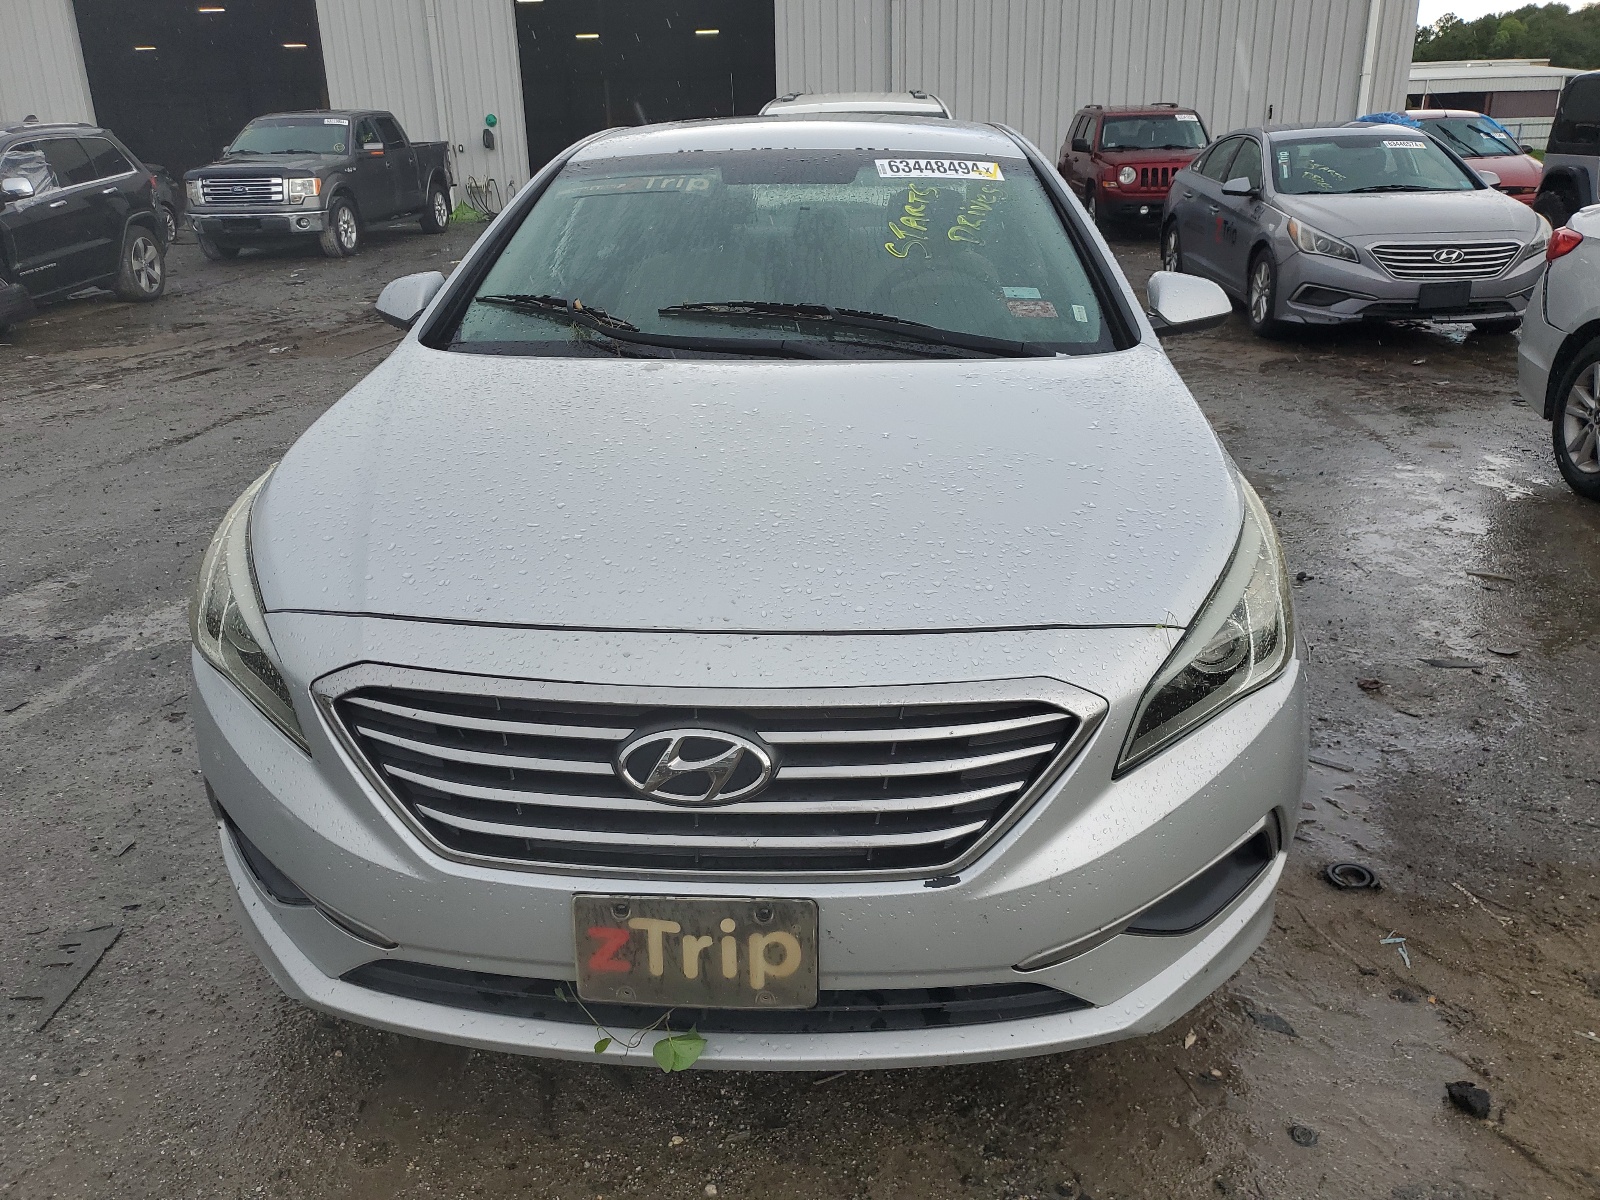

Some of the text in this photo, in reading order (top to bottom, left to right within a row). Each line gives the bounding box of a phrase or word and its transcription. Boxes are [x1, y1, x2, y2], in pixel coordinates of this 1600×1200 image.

[888, 159, 981, 175] 63448494
[884, 183, 940, 259] STARTS
[586, 917, 802, 990] zTrip
